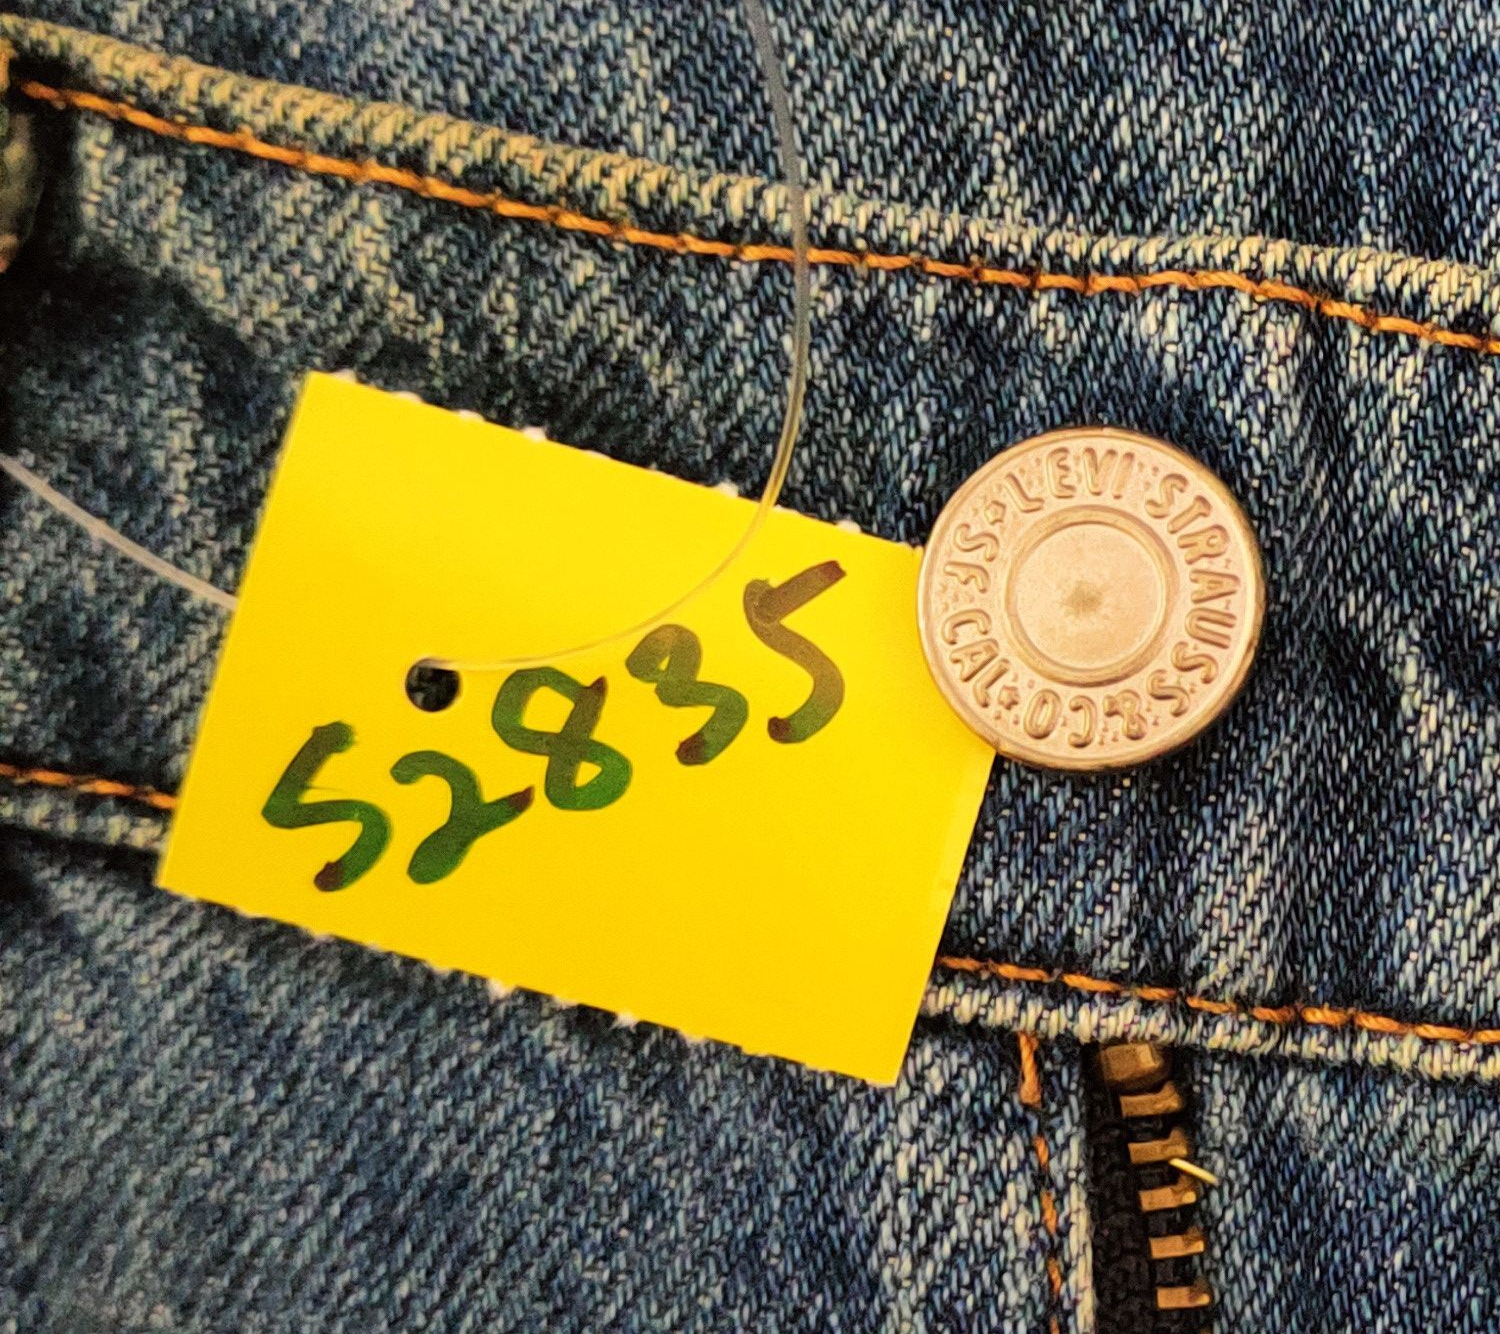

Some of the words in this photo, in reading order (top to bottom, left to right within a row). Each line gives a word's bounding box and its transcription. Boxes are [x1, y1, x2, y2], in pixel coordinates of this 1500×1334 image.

[941, 607, 1011, 709] CAL
[1002, 445, 1136, 514] LEVI
[1145, 472, 1241, 717] STRAUSS
